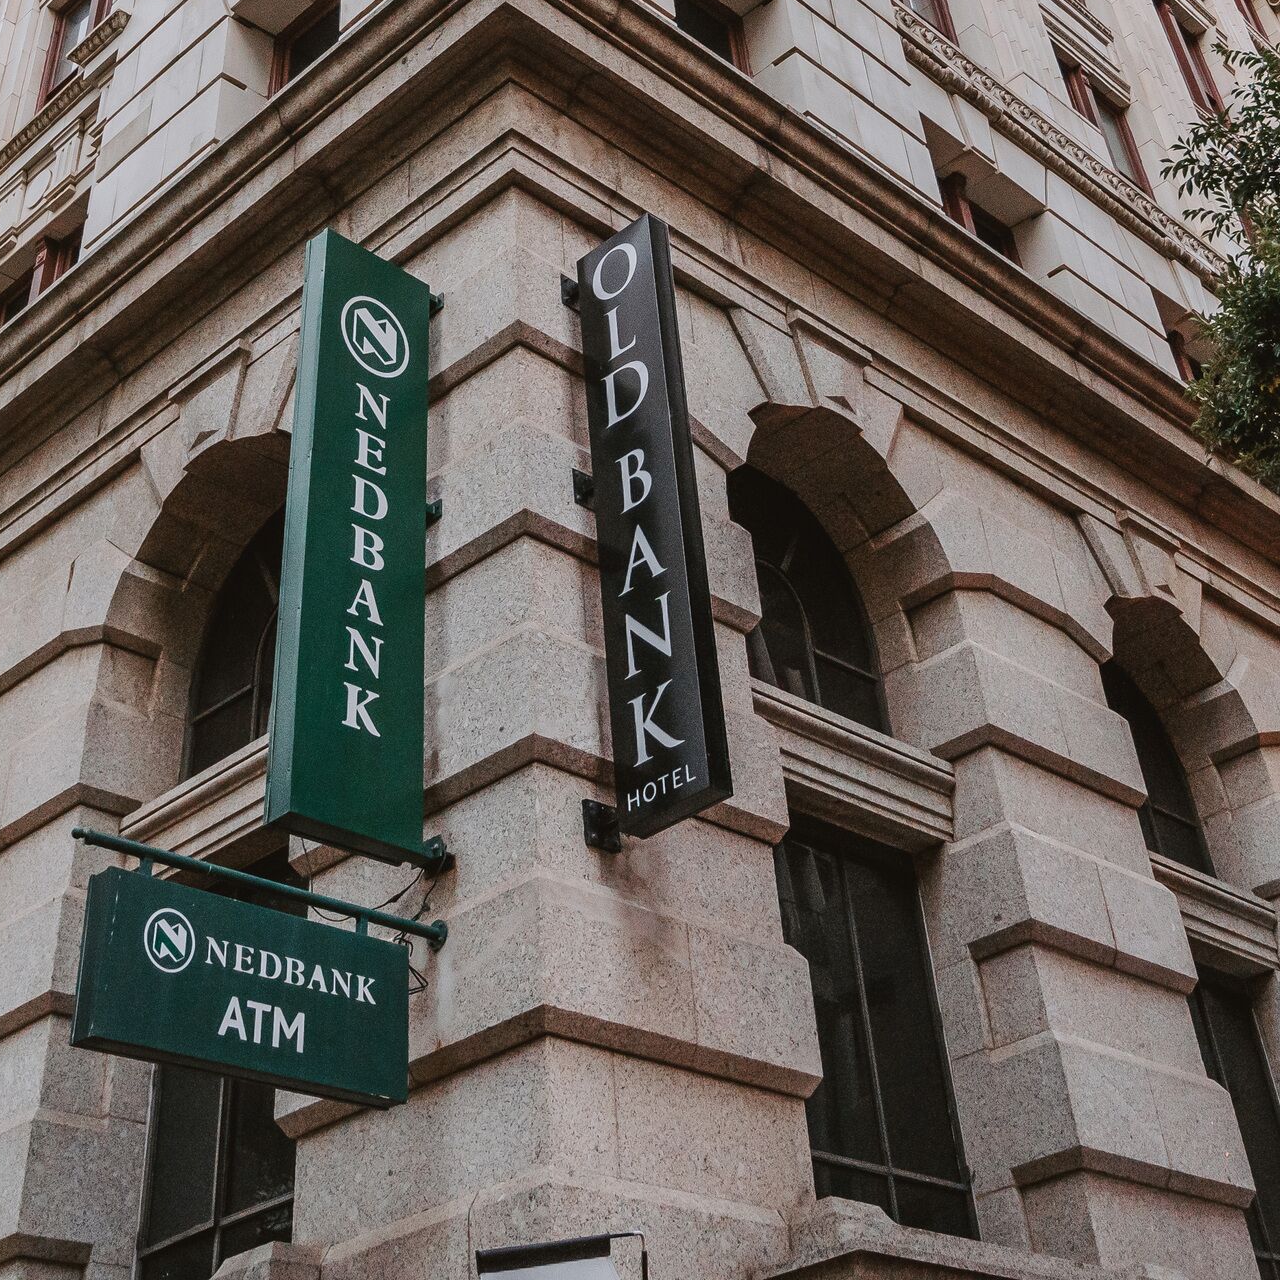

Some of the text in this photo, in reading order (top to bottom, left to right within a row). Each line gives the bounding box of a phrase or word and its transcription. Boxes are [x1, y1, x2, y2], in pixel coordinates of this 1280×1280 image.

[592, 242, 685, 768] OLD BANK
[341, 382, 391, 738] NEDBANK
[627, 764, 696, 812] HOTEL
[204, 935, 377, 1005] NEDBANK
[217, 995, 306, 1054] ATM
